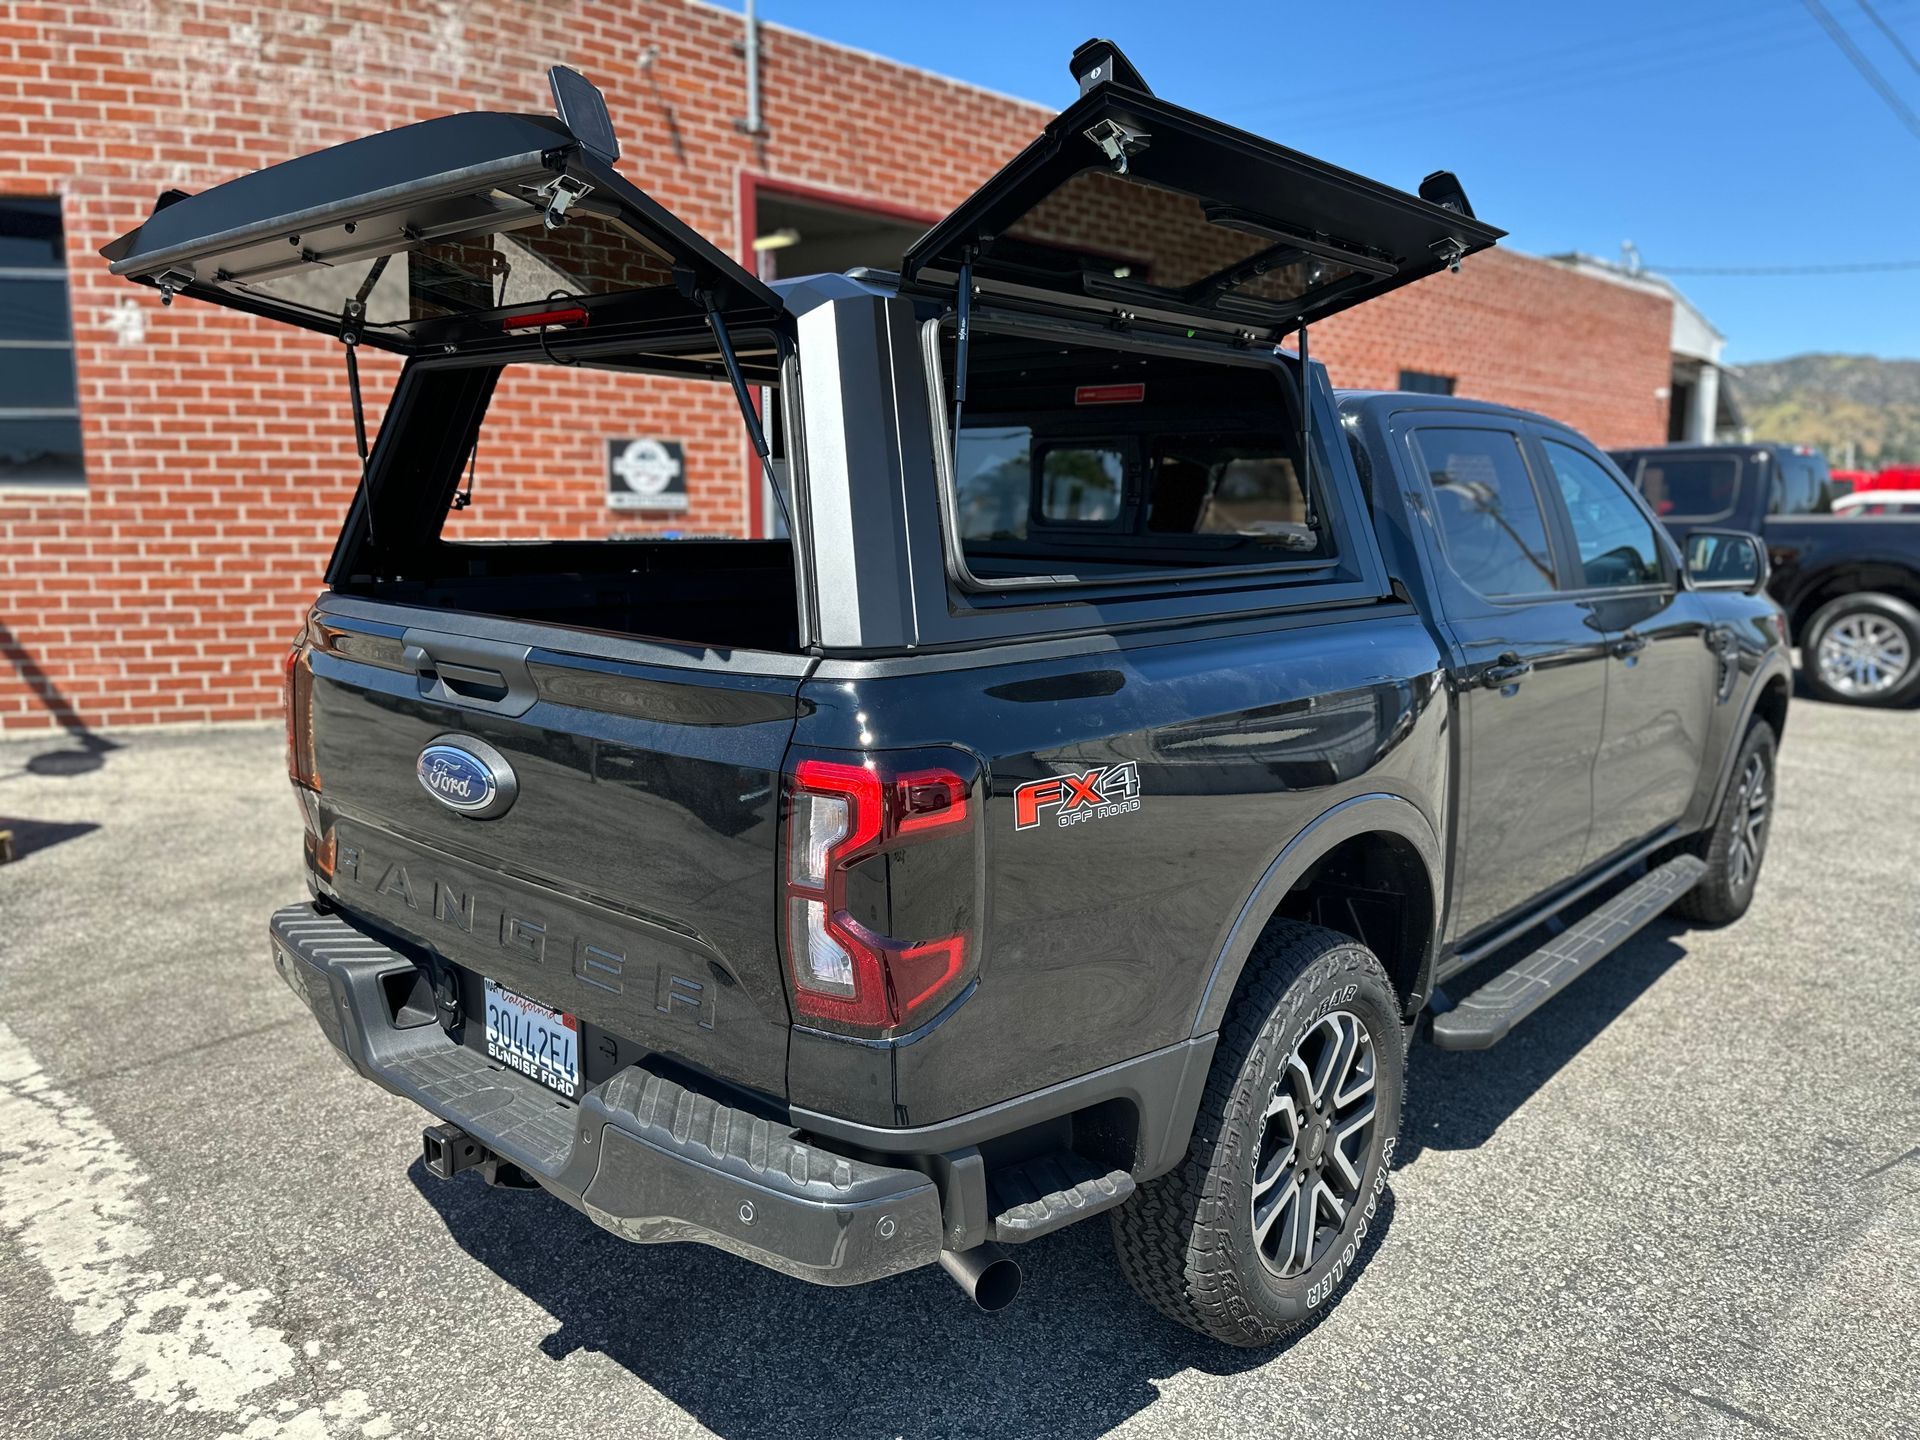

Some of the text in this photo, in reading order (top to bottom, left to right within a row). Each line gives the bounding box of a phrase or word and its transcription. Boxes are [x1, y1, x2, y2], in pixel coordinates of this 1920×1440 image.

[429, 758, 472, 798] Ford
[1014, 761, 1141, 831] FX4
[1058, 799, 1141, 828] OFF ROAD
[335, 841, 717, 1031] RANGER
[488, 1042, 575, 1097] SUNRISE FORD
[489, 1004, 575, 1081] 30442E4
[1306, 1137, 1396, 1309] WRANGLER
